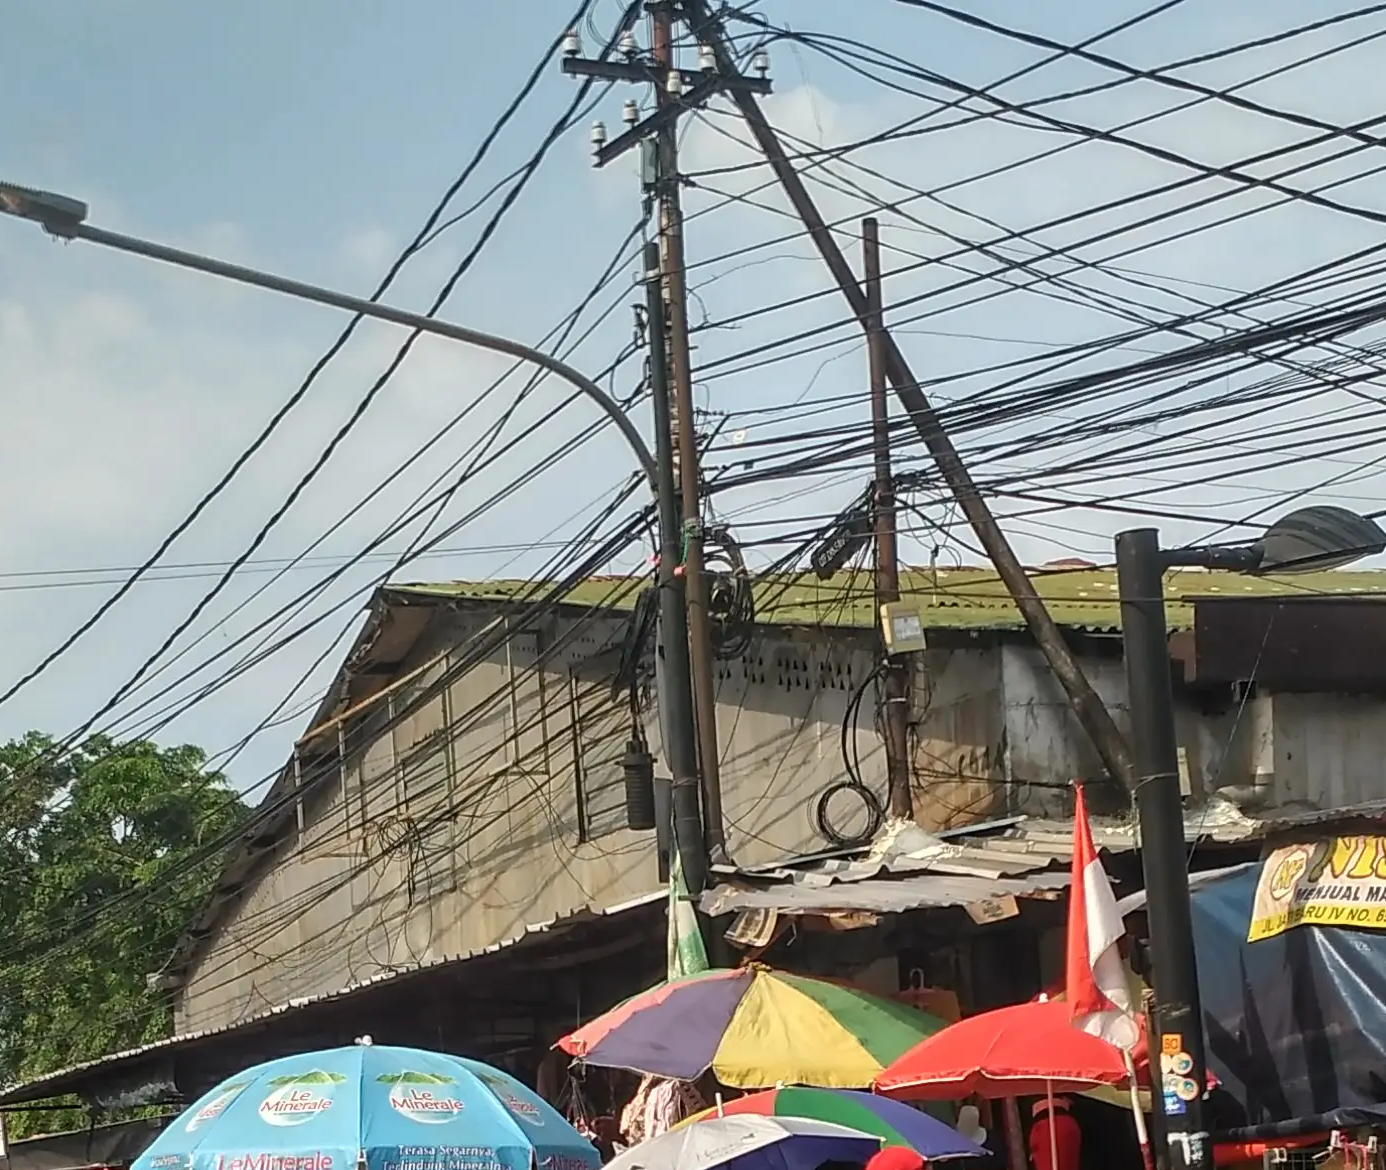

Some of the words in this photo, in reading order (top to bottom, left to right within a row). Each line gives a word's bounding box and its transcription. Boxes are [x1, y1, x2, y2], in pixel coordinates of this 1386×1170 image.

[1294, 884, 1361, 903] MENJUAL
[1346, 908, 1371, 922] NO.
[290, 1090, 311, 1102] Le
[411, 1089, 432, 1101] Le
[260, 1098, 334, 1113] Minerale
[391, 1098, 465, 1111] Minerale
[397, 1144, 436, 1157] Terasa
